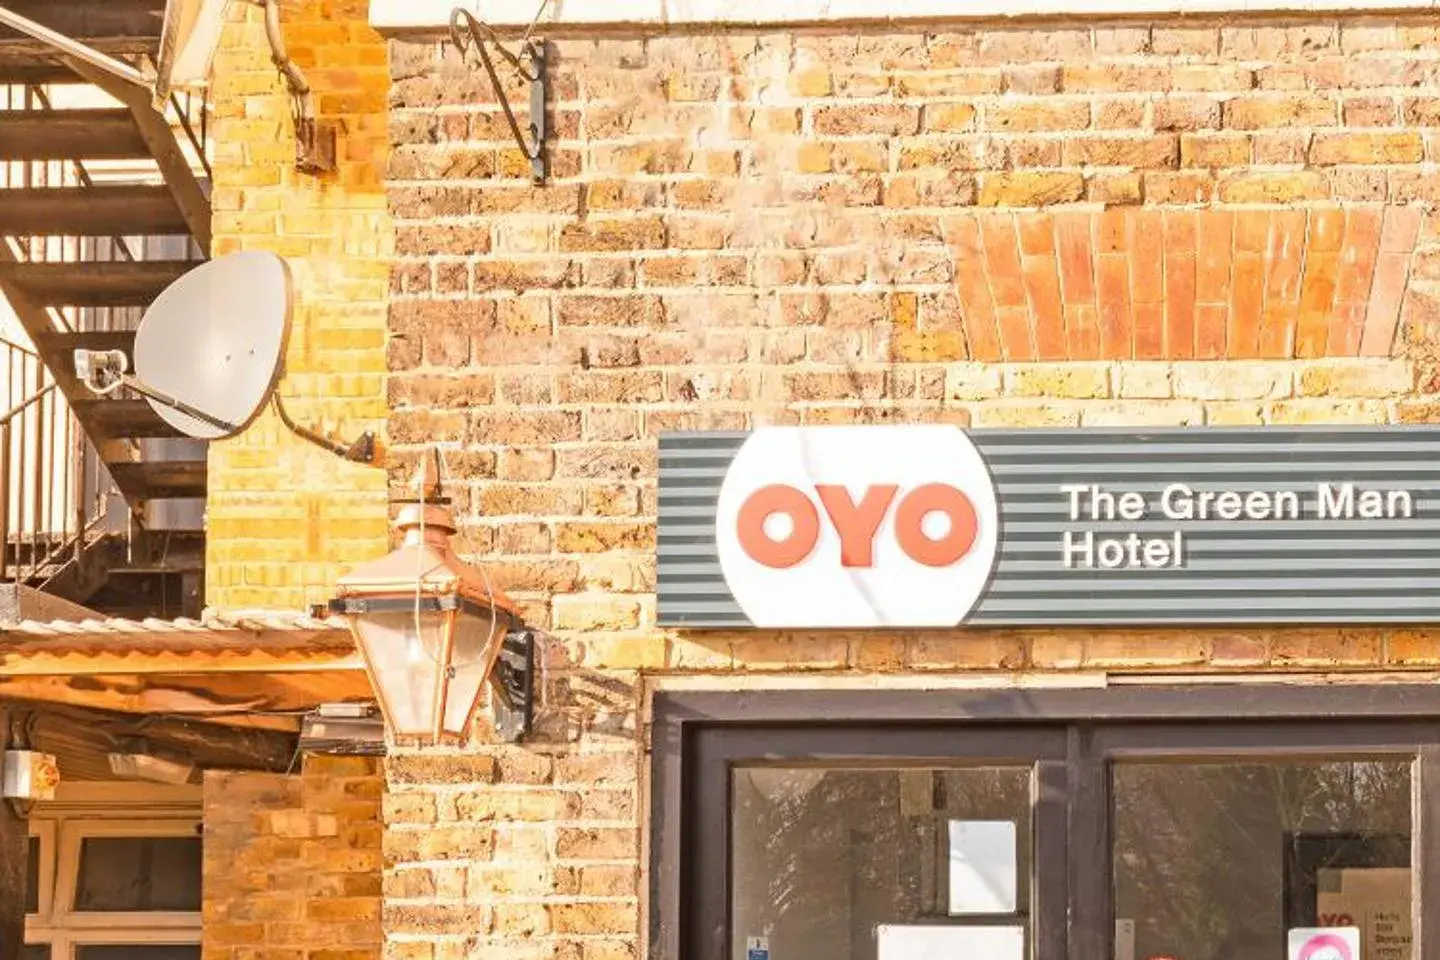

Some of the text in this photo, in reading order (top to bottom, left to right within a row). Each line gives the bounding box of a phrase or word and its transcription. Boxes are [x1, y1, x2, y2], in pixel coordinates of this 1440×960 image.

[1060, 483, 1412, 522] The Green Man
[736, 482, 977, 568] OYO
[1060, 531, 1186, 569] Hotel
